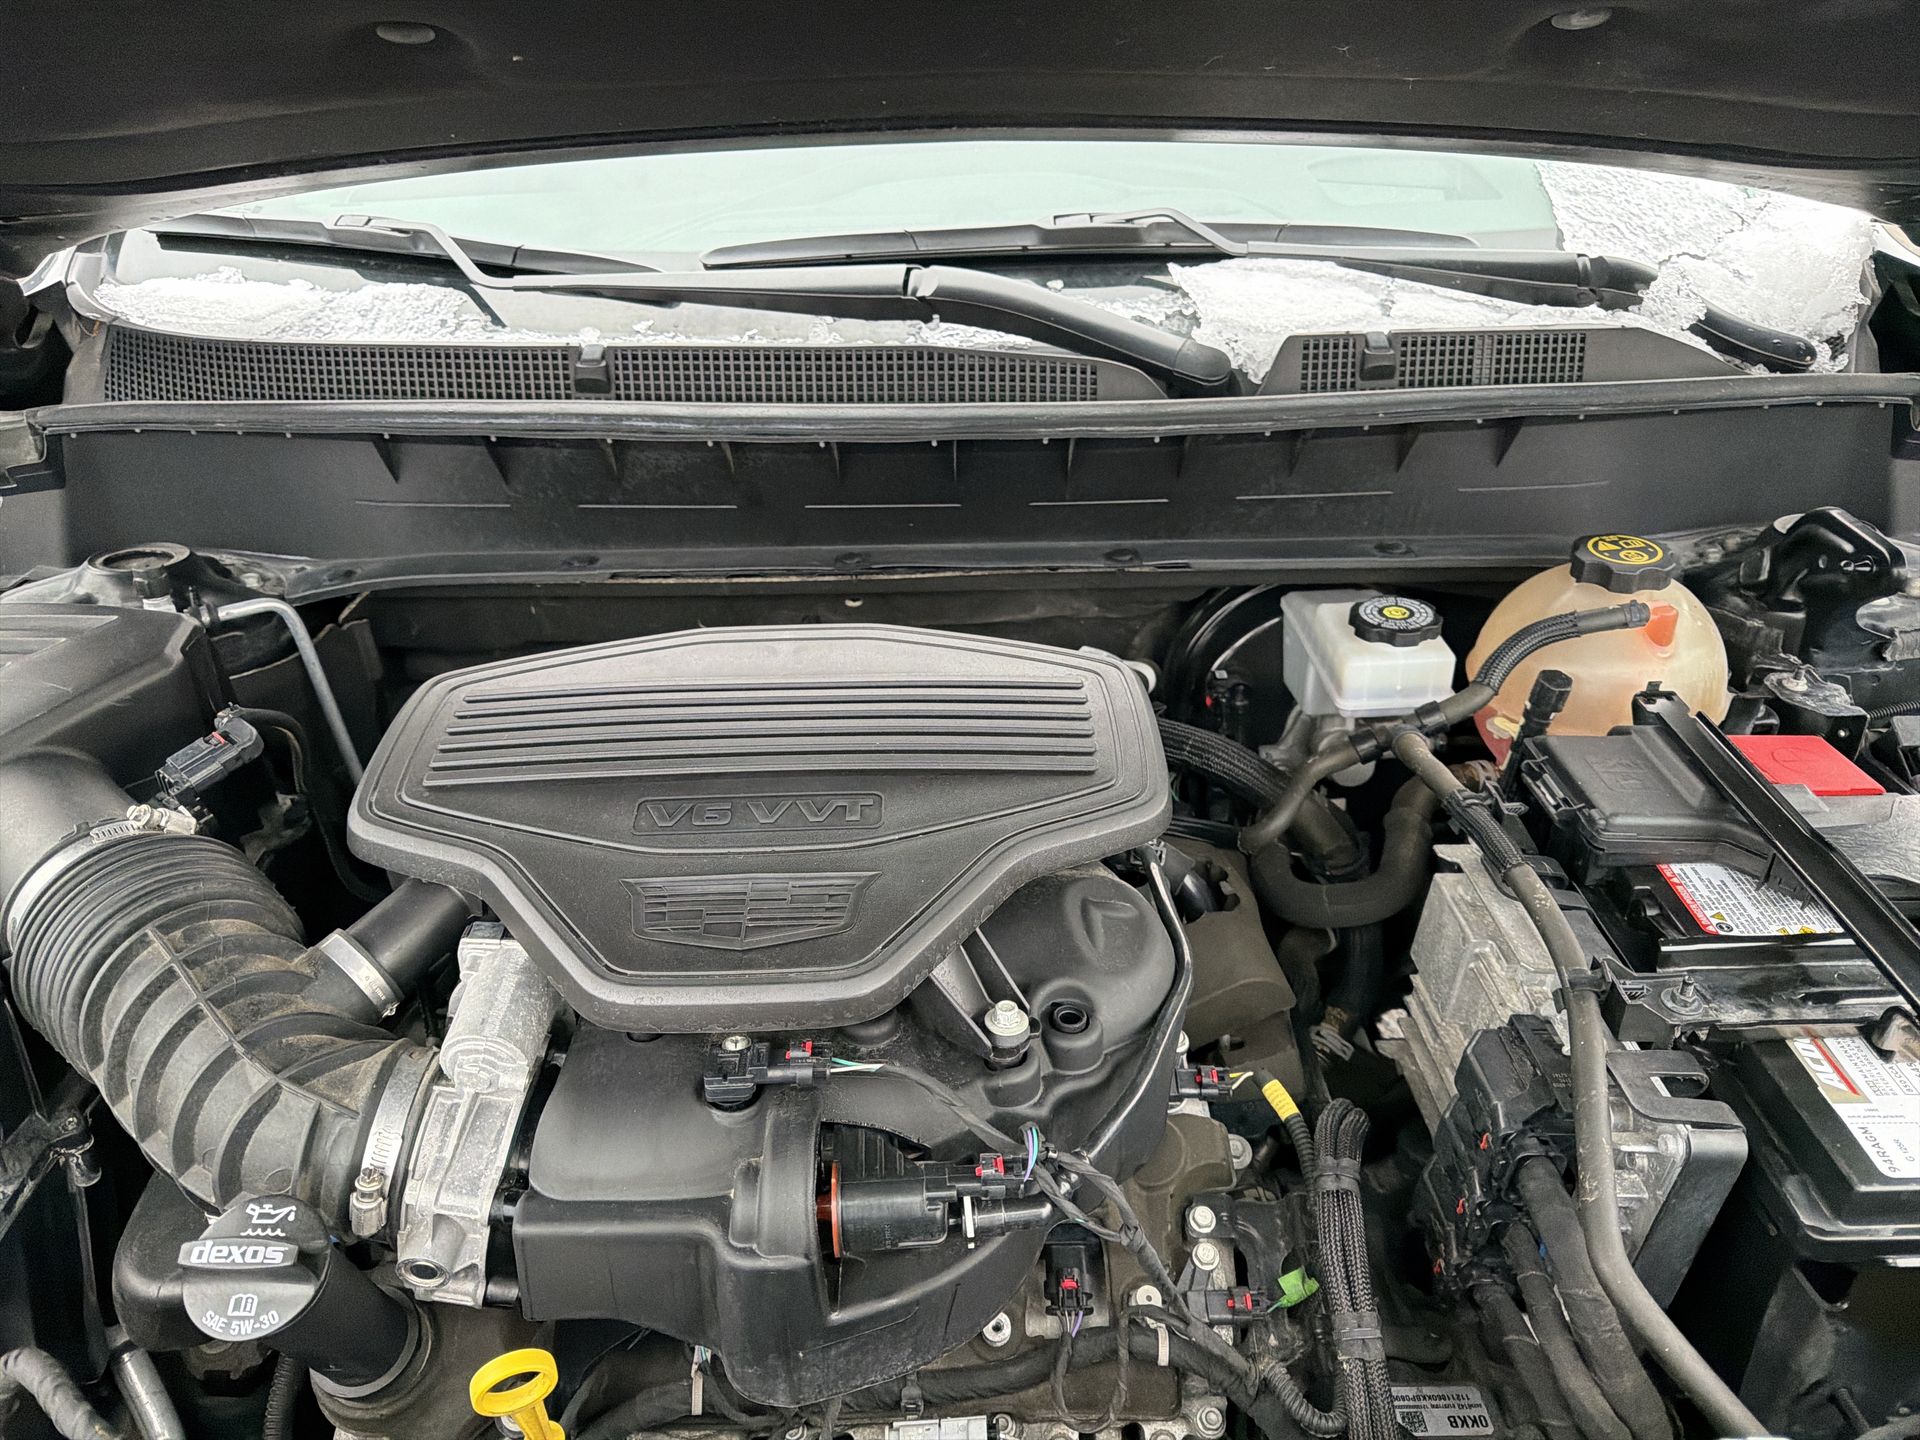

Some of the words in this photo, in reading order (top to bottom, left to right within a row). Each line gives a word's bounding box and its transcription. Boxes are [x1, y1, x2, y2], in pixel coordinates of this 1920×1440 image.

[647, 802, 732, 827] V6
[746, 798, 874, 823] VVT
[190, 1240, 287, 1264] dexos
[201, 1310, 226, 1333] SAE
[229, 1310, 280, 1335] 5W-30
